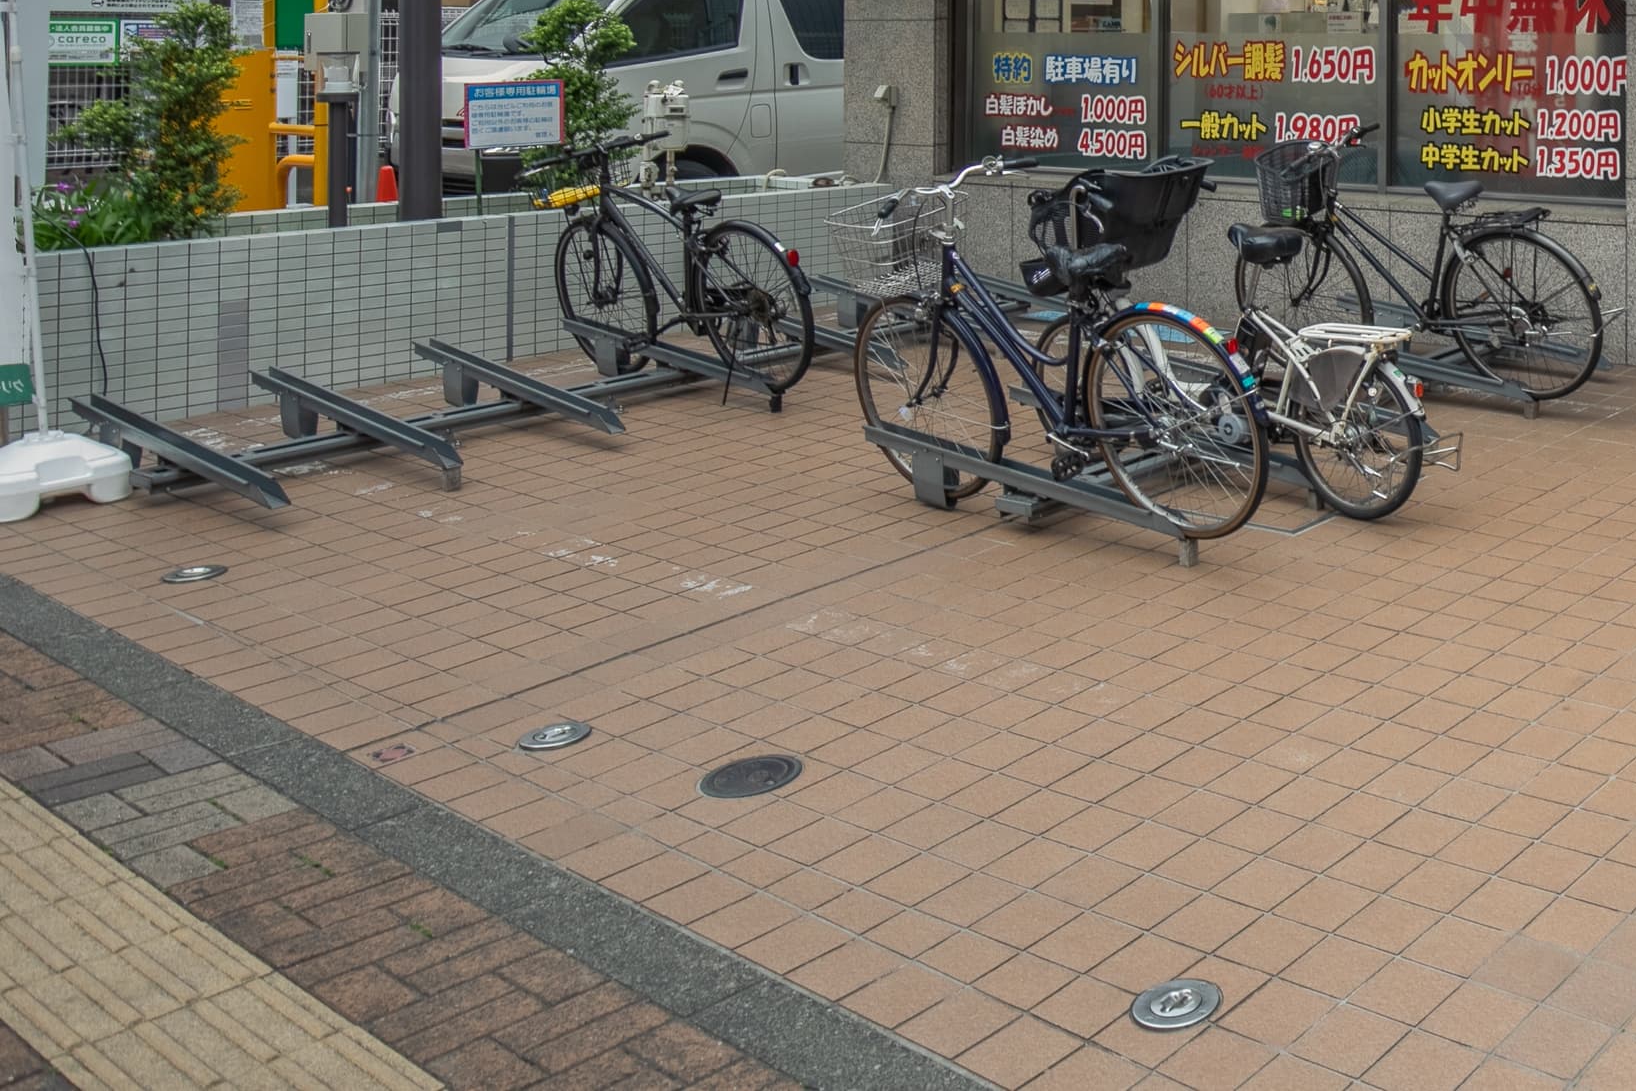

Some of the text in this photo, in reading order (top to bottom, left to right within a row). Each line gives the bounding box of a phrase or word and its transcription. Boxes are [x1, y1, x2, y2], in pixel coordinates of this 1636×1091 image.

[58, 35, 106, 44] careco
[993, 52, 1137, 84] 特約 駐車場有り
[1174, 40, 1285, 83] シルバー調髪
[1407, 50, 1535, 94] カットオンリー
[474, 85, 557, 97] お客様専用駐輪場
[985, 94, 1053, 116] 白髪ぼかし
[1180, 111, 1268, 141] 一般カット
[1420, 105, 1531, 137] 小学生カット
[1001, 125, 1059, 148] 白髪染め
[1420, 143, 1530, 174] 中学生カット
